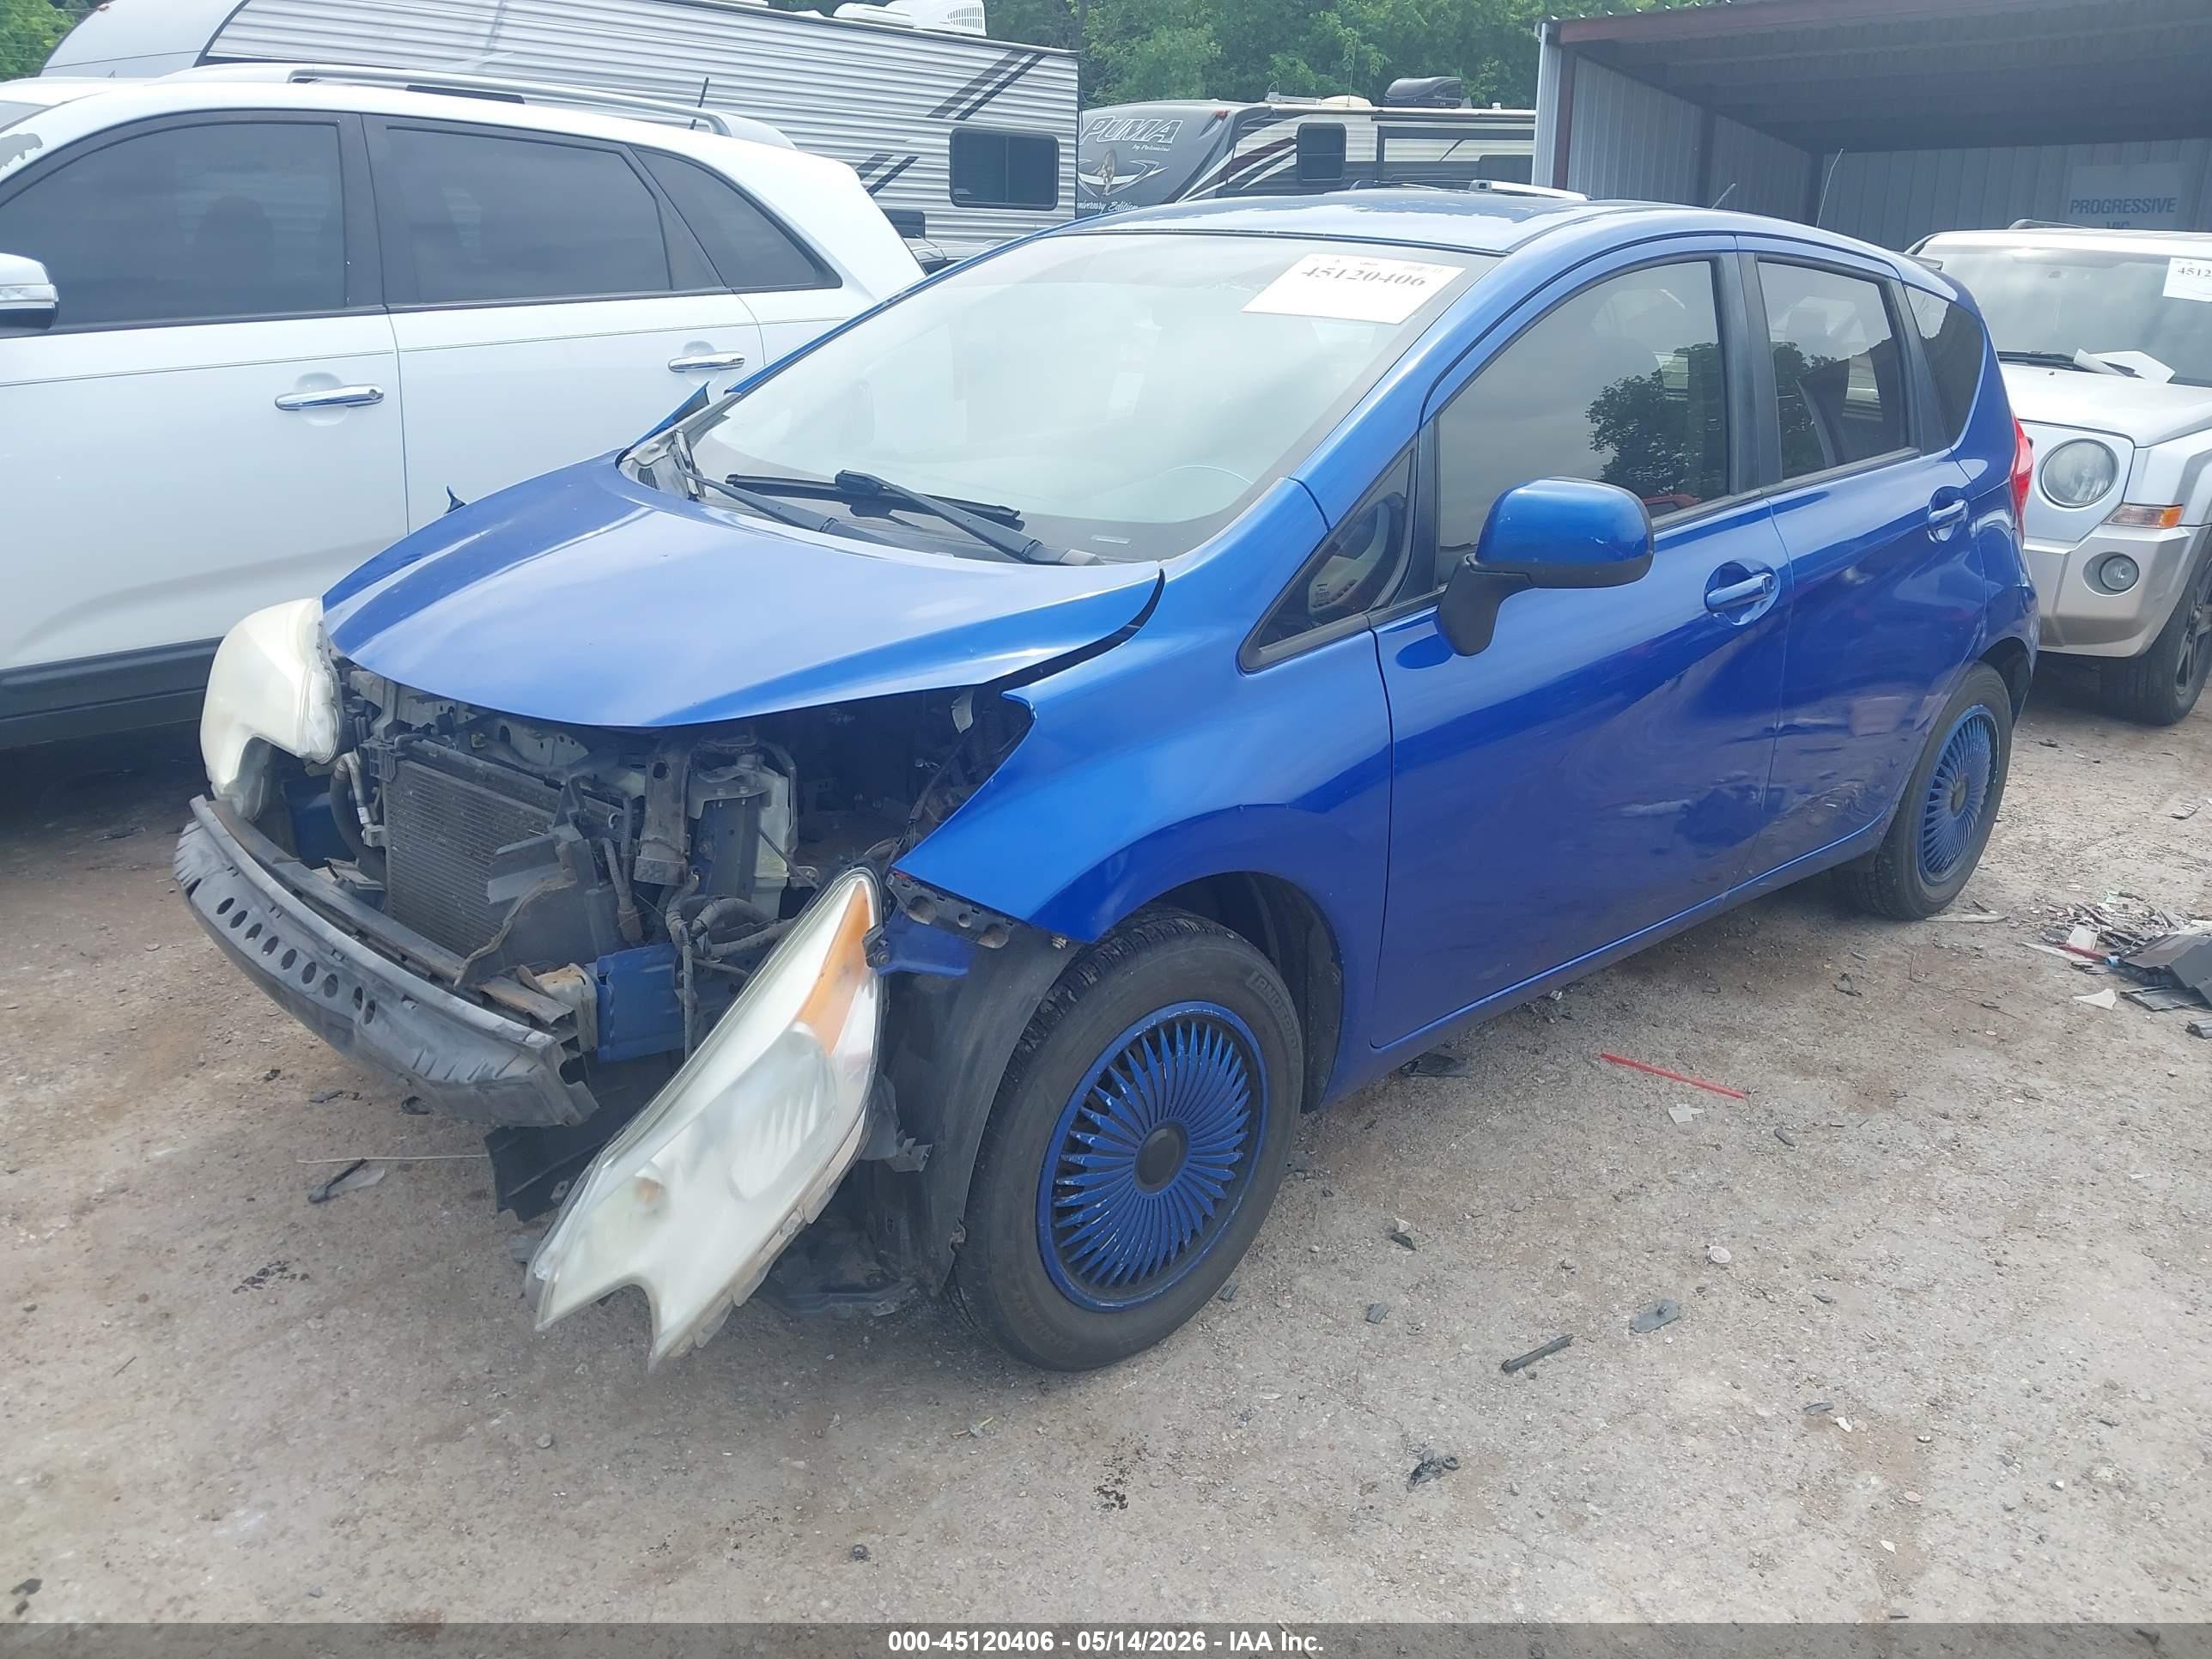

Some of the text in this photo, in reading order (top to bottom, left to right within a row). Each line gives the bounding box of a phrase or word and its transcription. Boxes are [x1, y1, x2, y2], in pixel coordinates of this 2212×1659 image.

[1079, 116, 1183, 145] PUMA
[2070, 198, 2177, 214] PROGRESSIVE
[1301, 266, 1426, 287] 45120406
